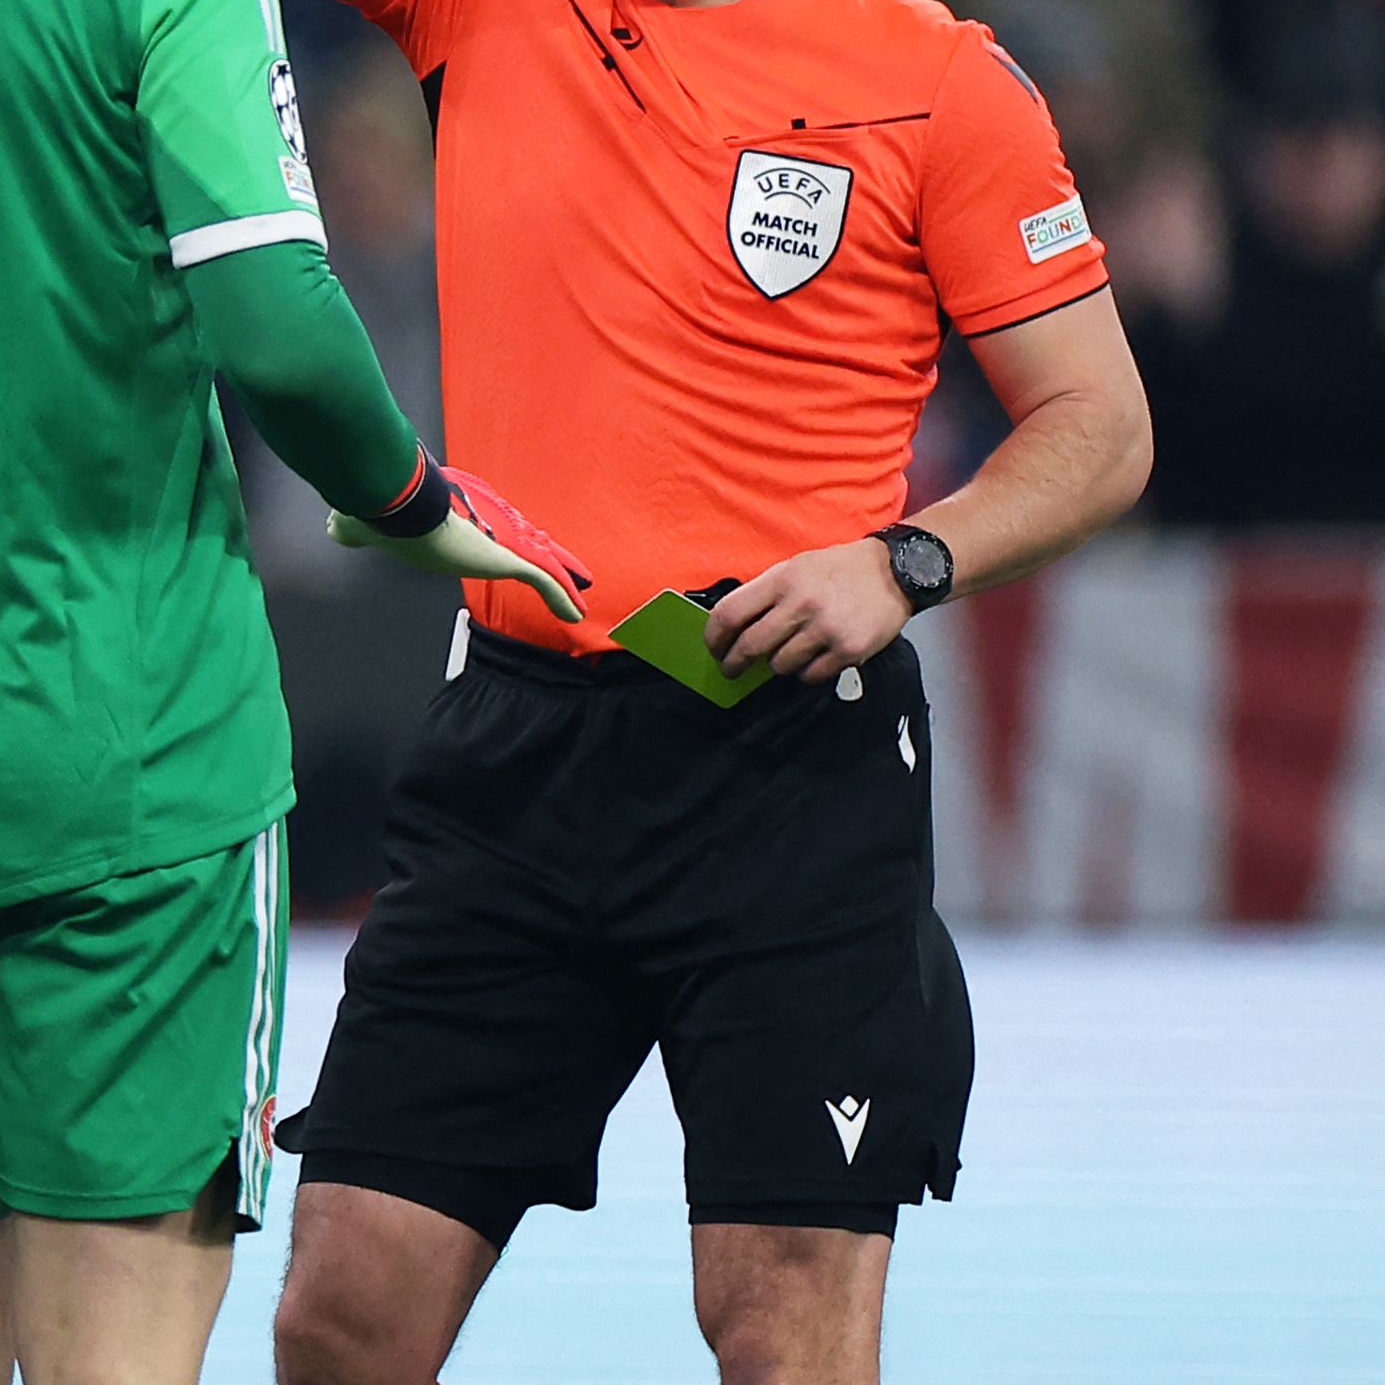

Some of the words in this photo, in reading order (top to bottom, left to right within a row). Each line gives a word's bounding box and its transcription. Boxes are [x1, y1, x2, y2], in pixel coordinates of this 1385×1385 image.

[757, 172, 824, 205] UEFA
[751, 210, 818, 238] MATCH
[1023, 216, 1048, 233] UEFA
[740, 230, 820, 260] OFFICIAL
